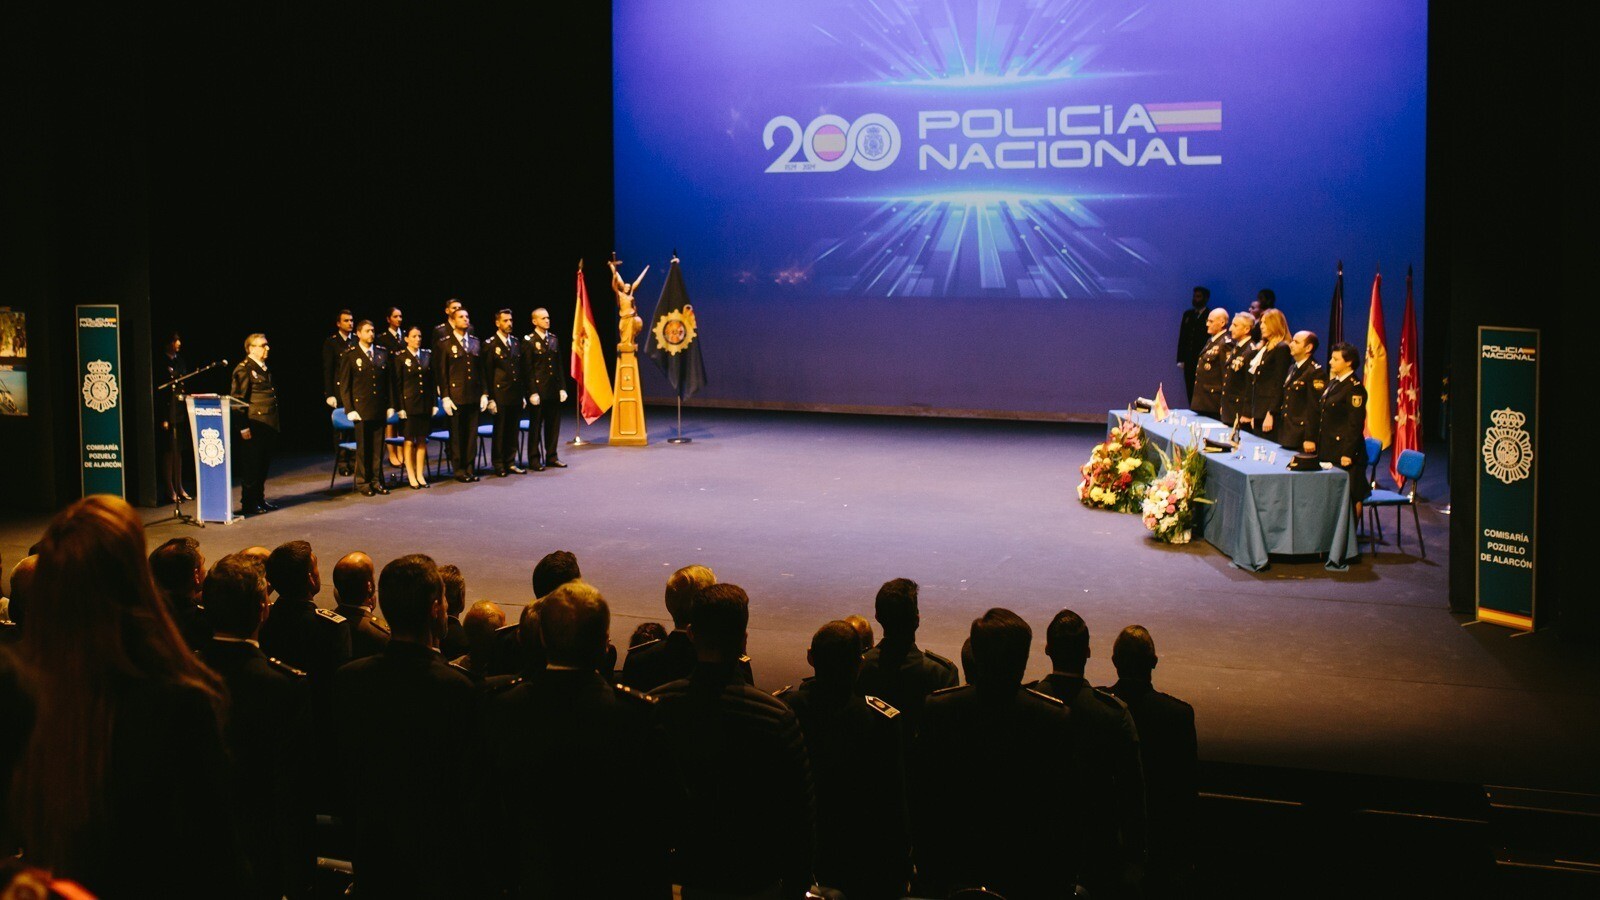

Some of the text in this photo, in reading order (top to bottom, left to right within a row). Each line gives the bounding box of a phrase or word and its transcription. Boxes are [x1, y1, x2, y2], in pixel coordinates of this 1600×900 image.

[763, 113, 901, 173] 200
[919, 137, 1222, 170] NACIONAL
[1482, 351, 1536, 361] NACIONAL
[88, 452, 117, 460] POZUELO
[1484, 528, 1529, 543] COMISARÍA
[1487, 541, 1526, 555] POZUELO
[1480, 552, 1533, 569] DE ALARCÓN
